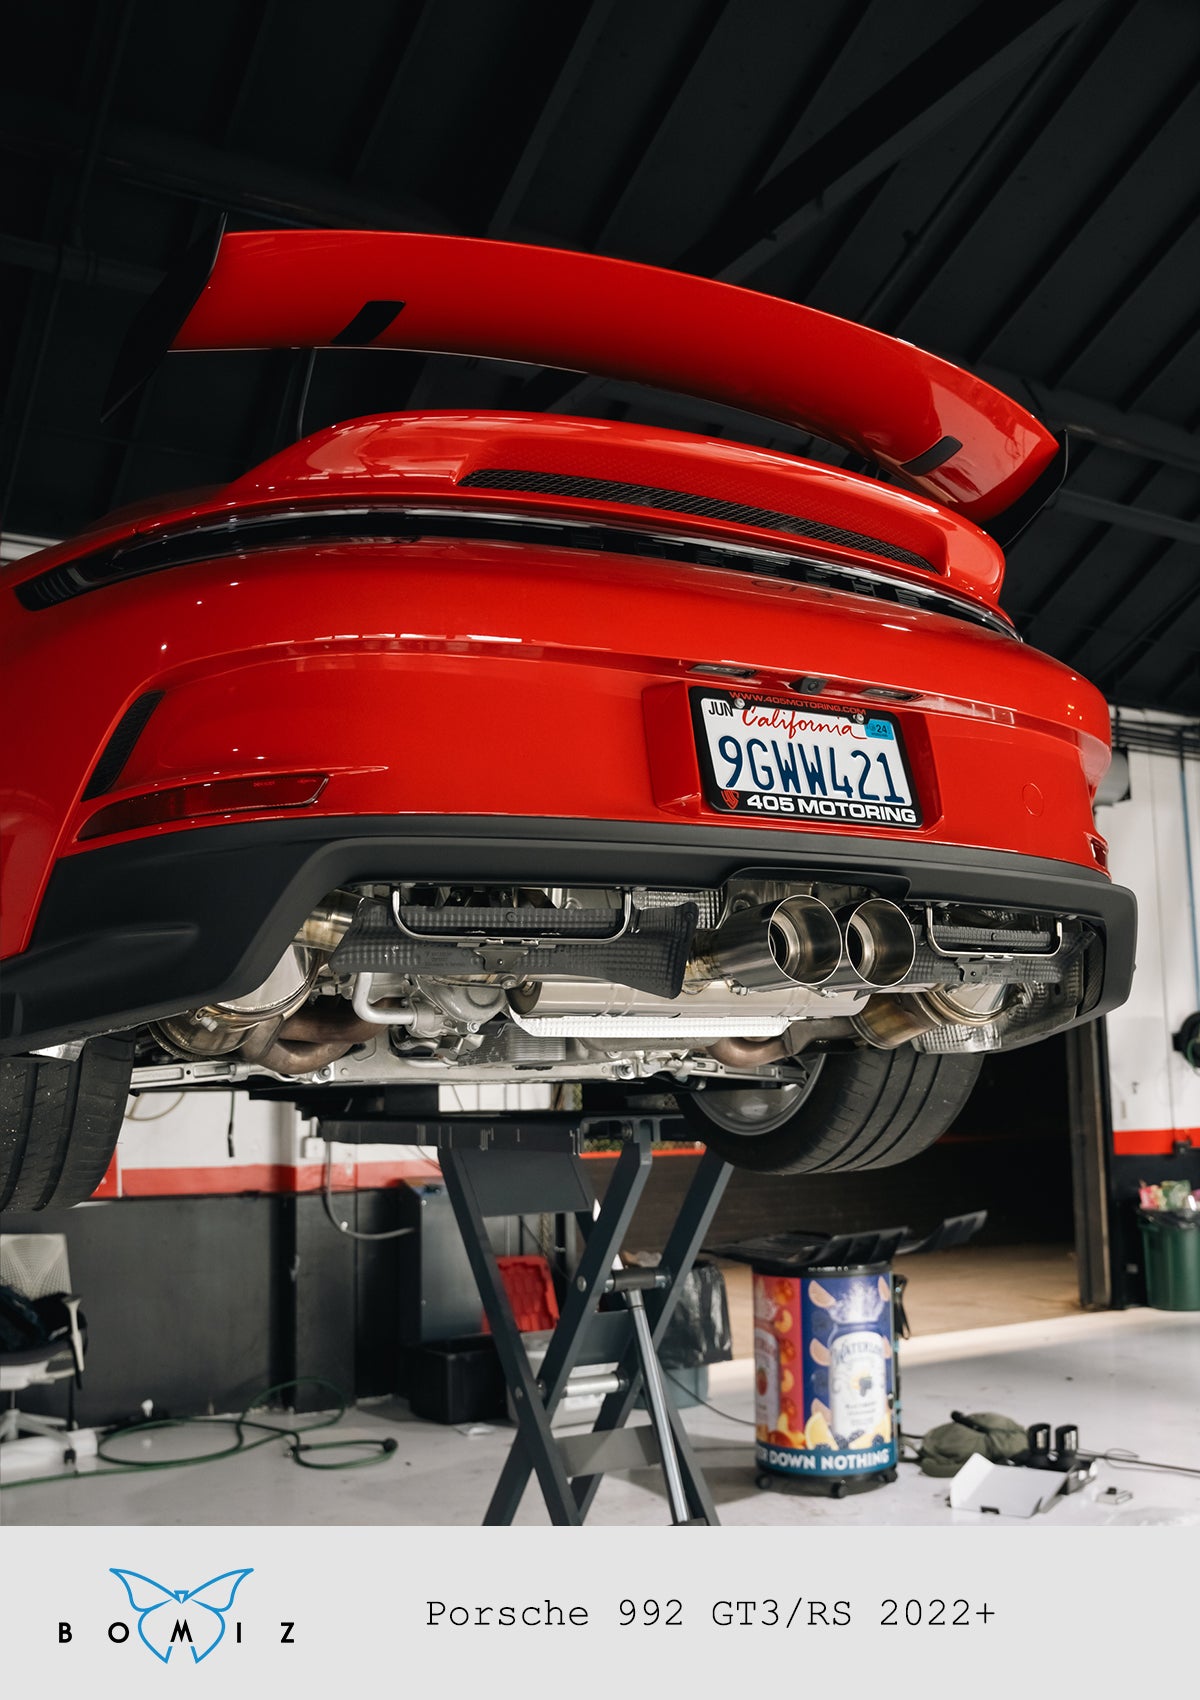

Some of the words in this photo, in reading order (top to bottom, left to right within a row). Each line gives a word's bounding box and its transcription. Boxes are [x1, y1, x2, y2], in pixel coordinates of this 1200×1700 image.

[709, 701, 733, 717] JUN
[729, 691, 866, 715] WWW.405MOTORING.COM
[742, 706, 867, 739] California
[718, 735, 905, 804] 9GWW421
[747, 794, 793, 814] 405
[799, 798, 917, 823] MOTORING
[769, 1451, 816, 1470] DOWN
[821, 1448, 889, 1471] NOTHING
